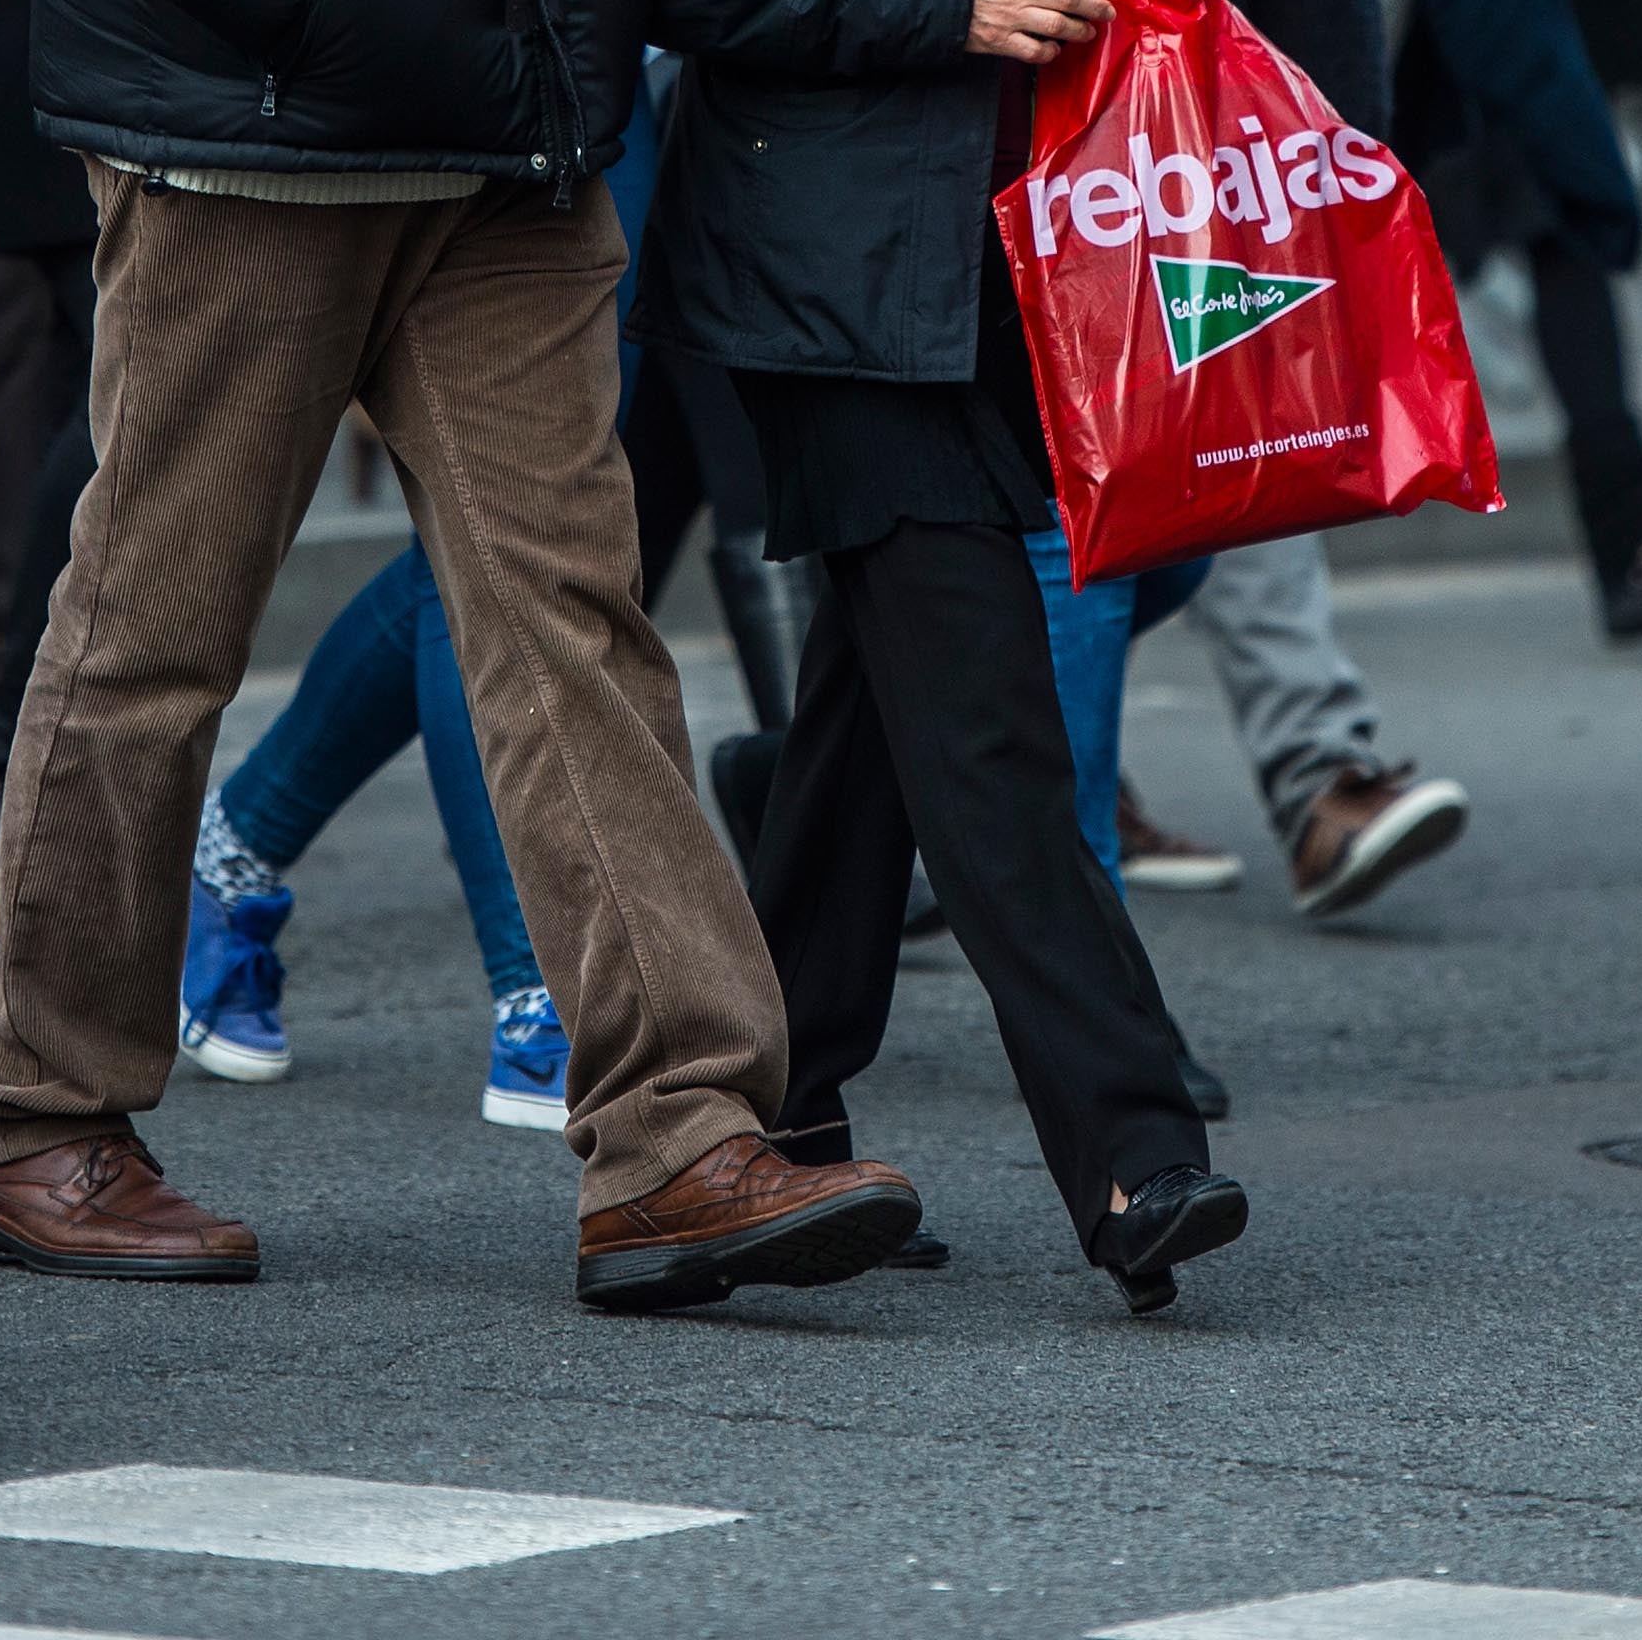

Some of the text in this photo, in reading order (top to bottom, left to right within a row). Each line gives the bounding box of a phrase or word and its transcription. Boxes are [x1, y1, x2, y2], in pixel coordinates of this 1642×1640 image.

[1026, 115, 1397, 257] rebajas
[1170, 297, 1191, 319] El
[1191, 292, 1238, 316] Corte
[1196, 423, 1370, 468] www.elcorteingles.es
